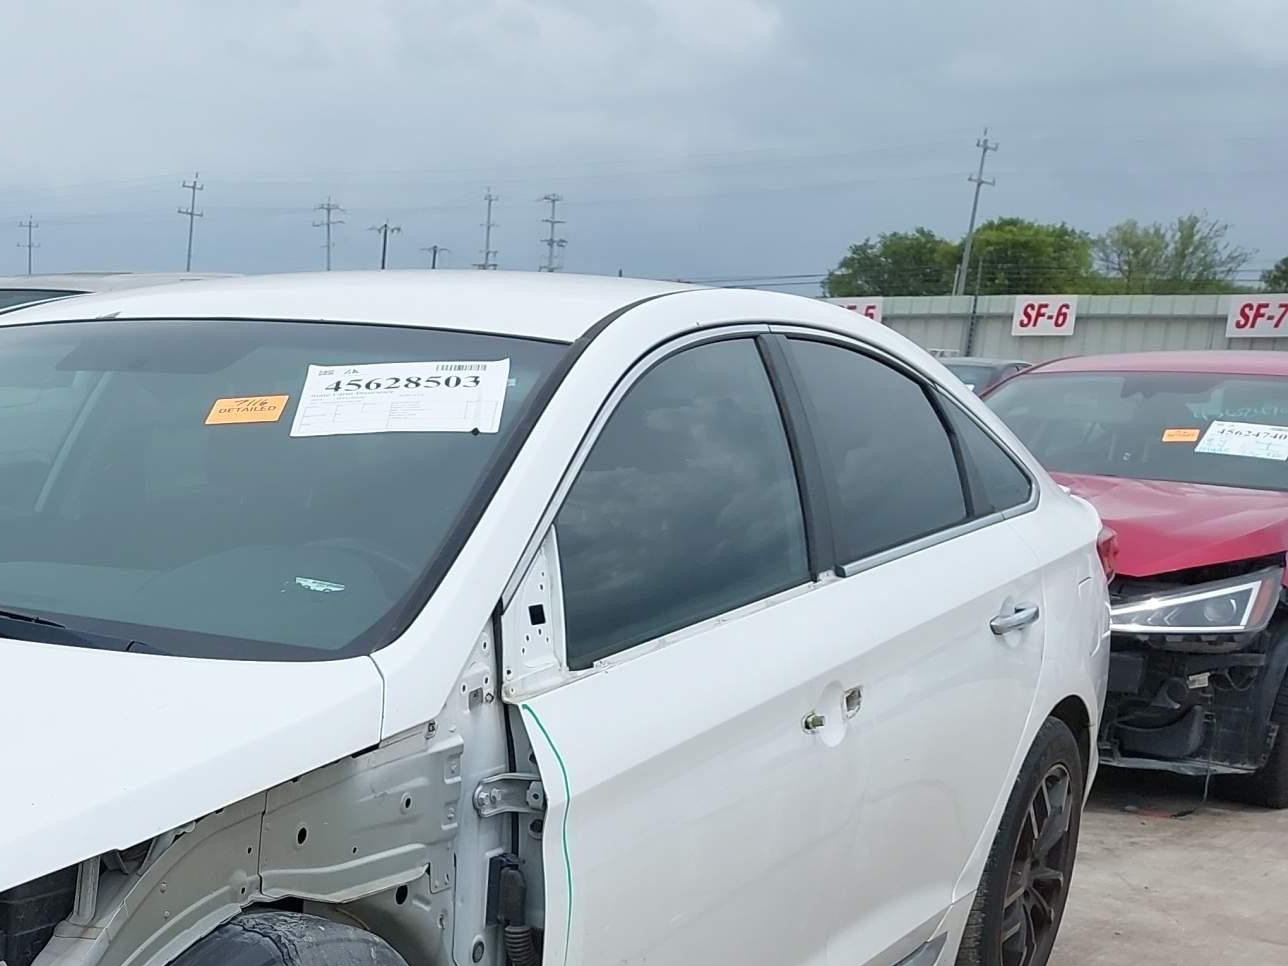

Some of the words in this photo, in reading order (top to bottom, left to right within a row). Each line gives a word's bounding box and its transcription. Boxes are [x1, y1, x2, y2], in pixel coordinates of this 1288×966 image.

[1019, 303, 1070, 328] SF-6
[1235, 302, 1288, 329] SF-7
[324, 375, 480, 392] 45628503
[218, 405, 277, 414] DETAILED
